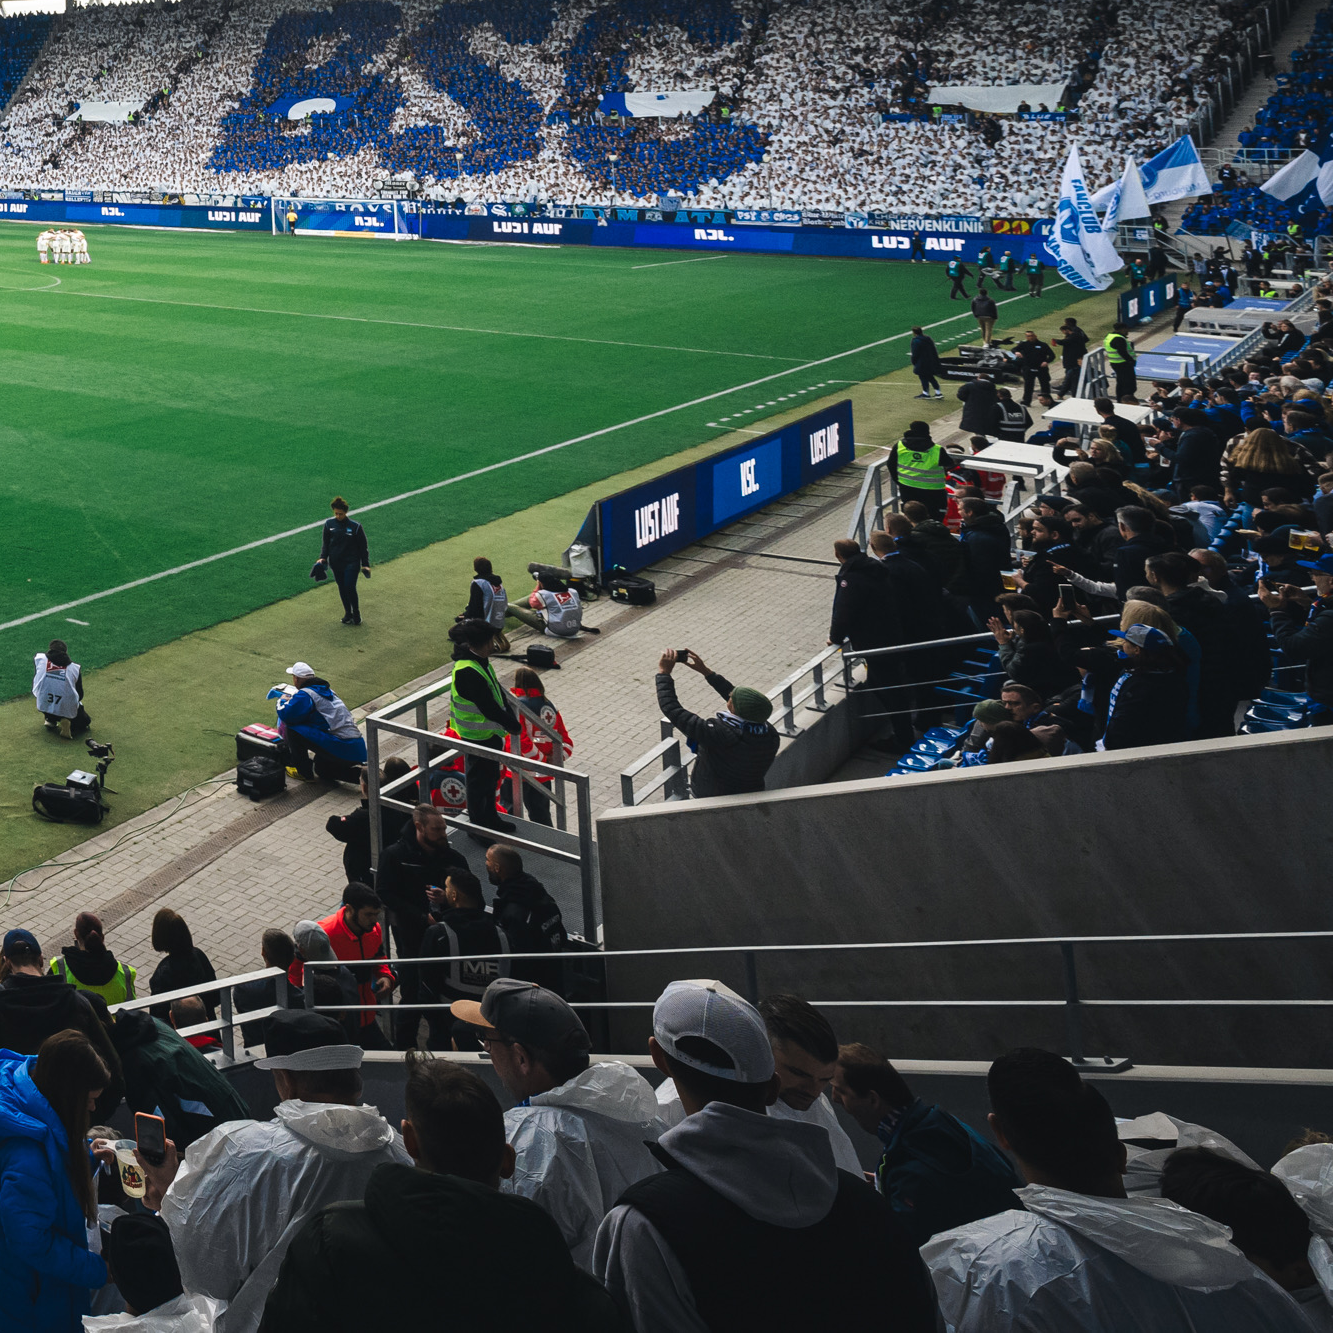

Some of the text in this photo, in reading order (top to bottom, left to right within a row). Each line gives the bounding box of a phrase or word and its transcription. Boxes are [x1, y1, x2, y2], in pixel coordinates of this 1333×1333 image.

[1071, 179, 1102, 233] FANCLUB
[810, 422, 839, 465] LUST AUF
[740, 458, 760, 496] KSC.
[635, 492, 679, 548] LUST AUF
[47, 693, 62, 704] 37
